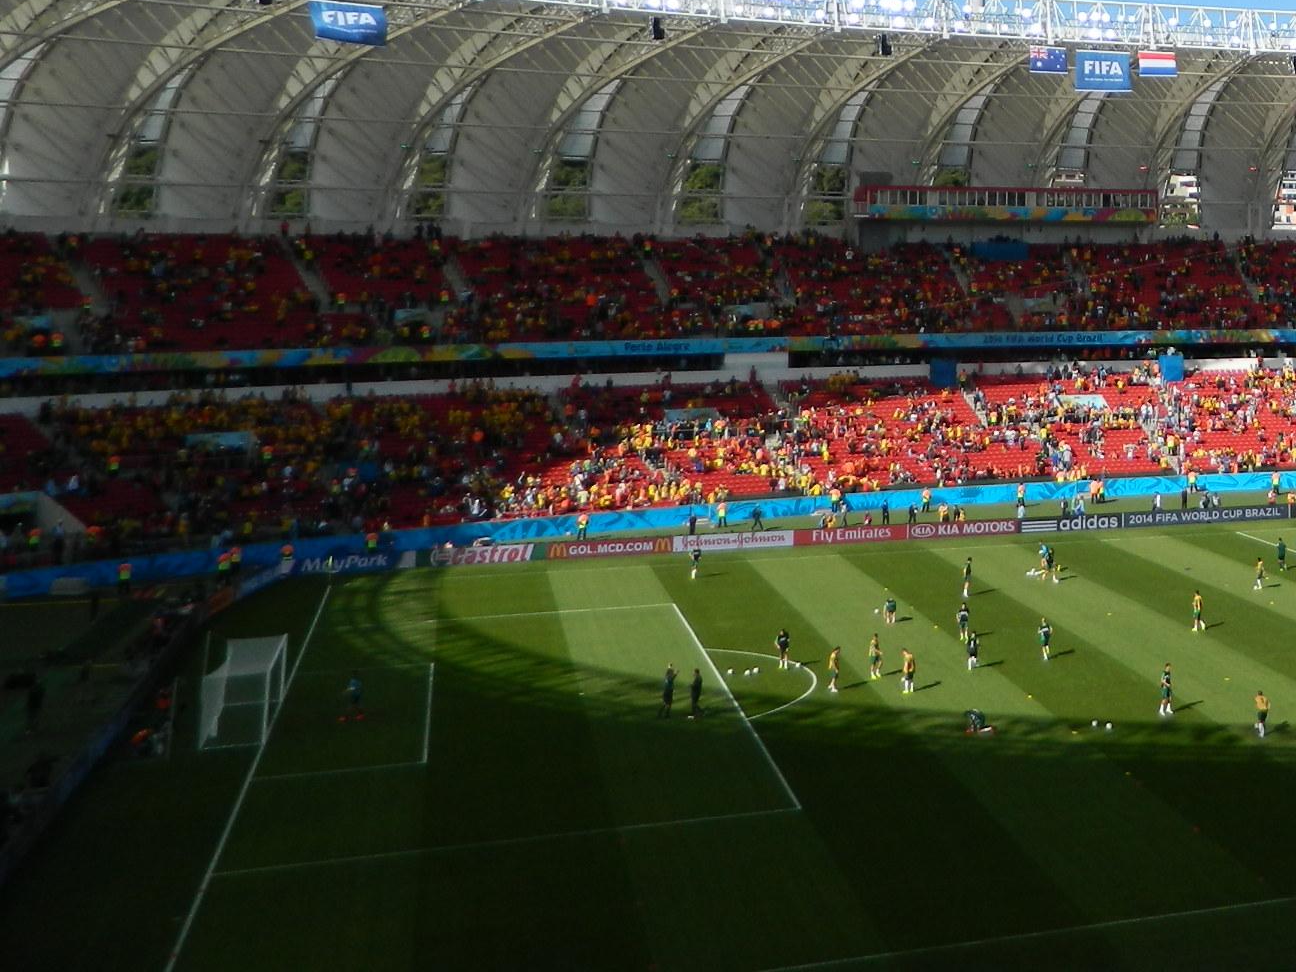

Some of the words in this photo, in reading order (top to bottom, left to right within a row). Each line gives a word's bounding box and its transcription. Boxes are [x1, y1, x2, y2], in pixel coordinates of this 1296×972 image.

[322, 10, 377, 26] FIFA
[1084, 60, 1123, 75] FIFA
[1060, 515, 1118, 530] adidas
[1129, 514, 1153, 524] 2014
[1156, 512, 1178, 522] FIFA
[1182, 510, 1219, 521] WORLD
[1222, 509, 1243, 518] CUP
[1245, 507, 1280, 517] BRAZIL
[812, 531, 834, 544] Fly
[836, 526, 891, 540] Emirates
[938, 524, 959, 534] KIA
[963, 521, 1015, 533] MOTORS
[569, 541, 654, 556] GOL.MCD.COM
